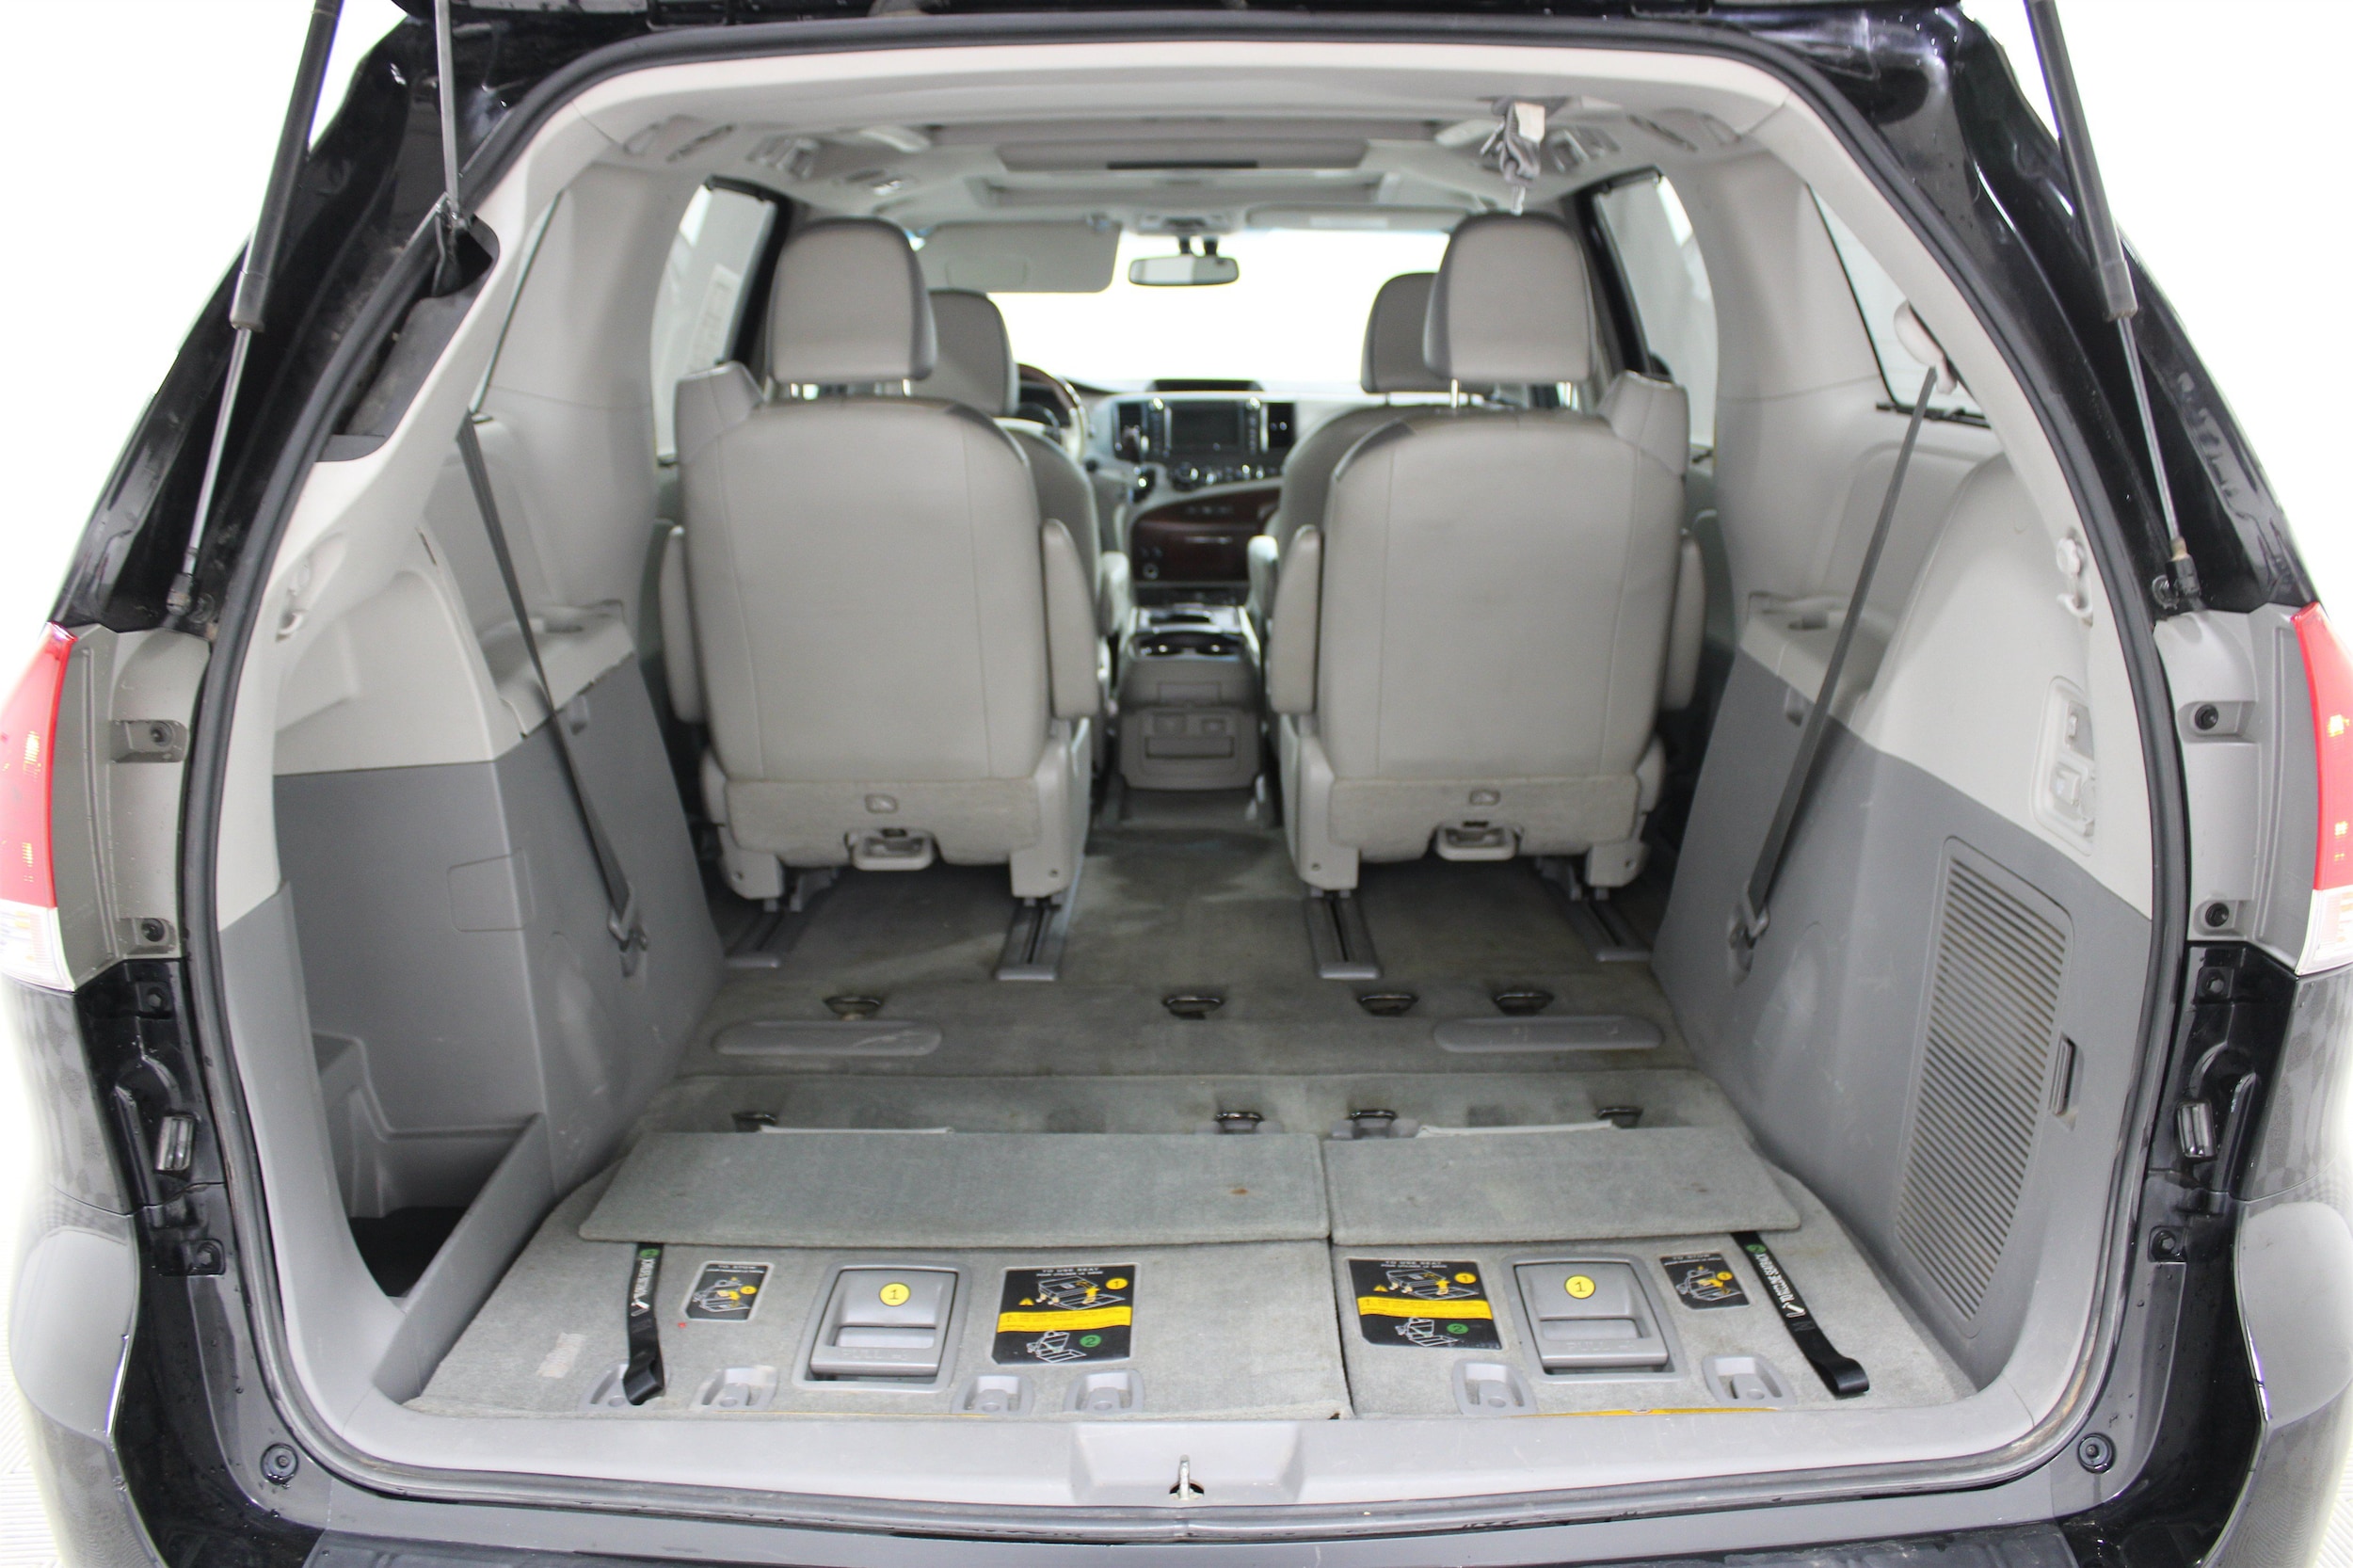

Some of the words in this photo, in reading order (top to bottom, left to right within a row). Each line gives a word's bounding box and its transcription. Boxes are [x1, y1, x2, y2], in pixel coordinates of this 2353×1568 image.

[1575, 1281, 1586, 1292] 1
[888, 1288, 900, 1300] 1
[1085, 1337, 1096, 1346] 2
